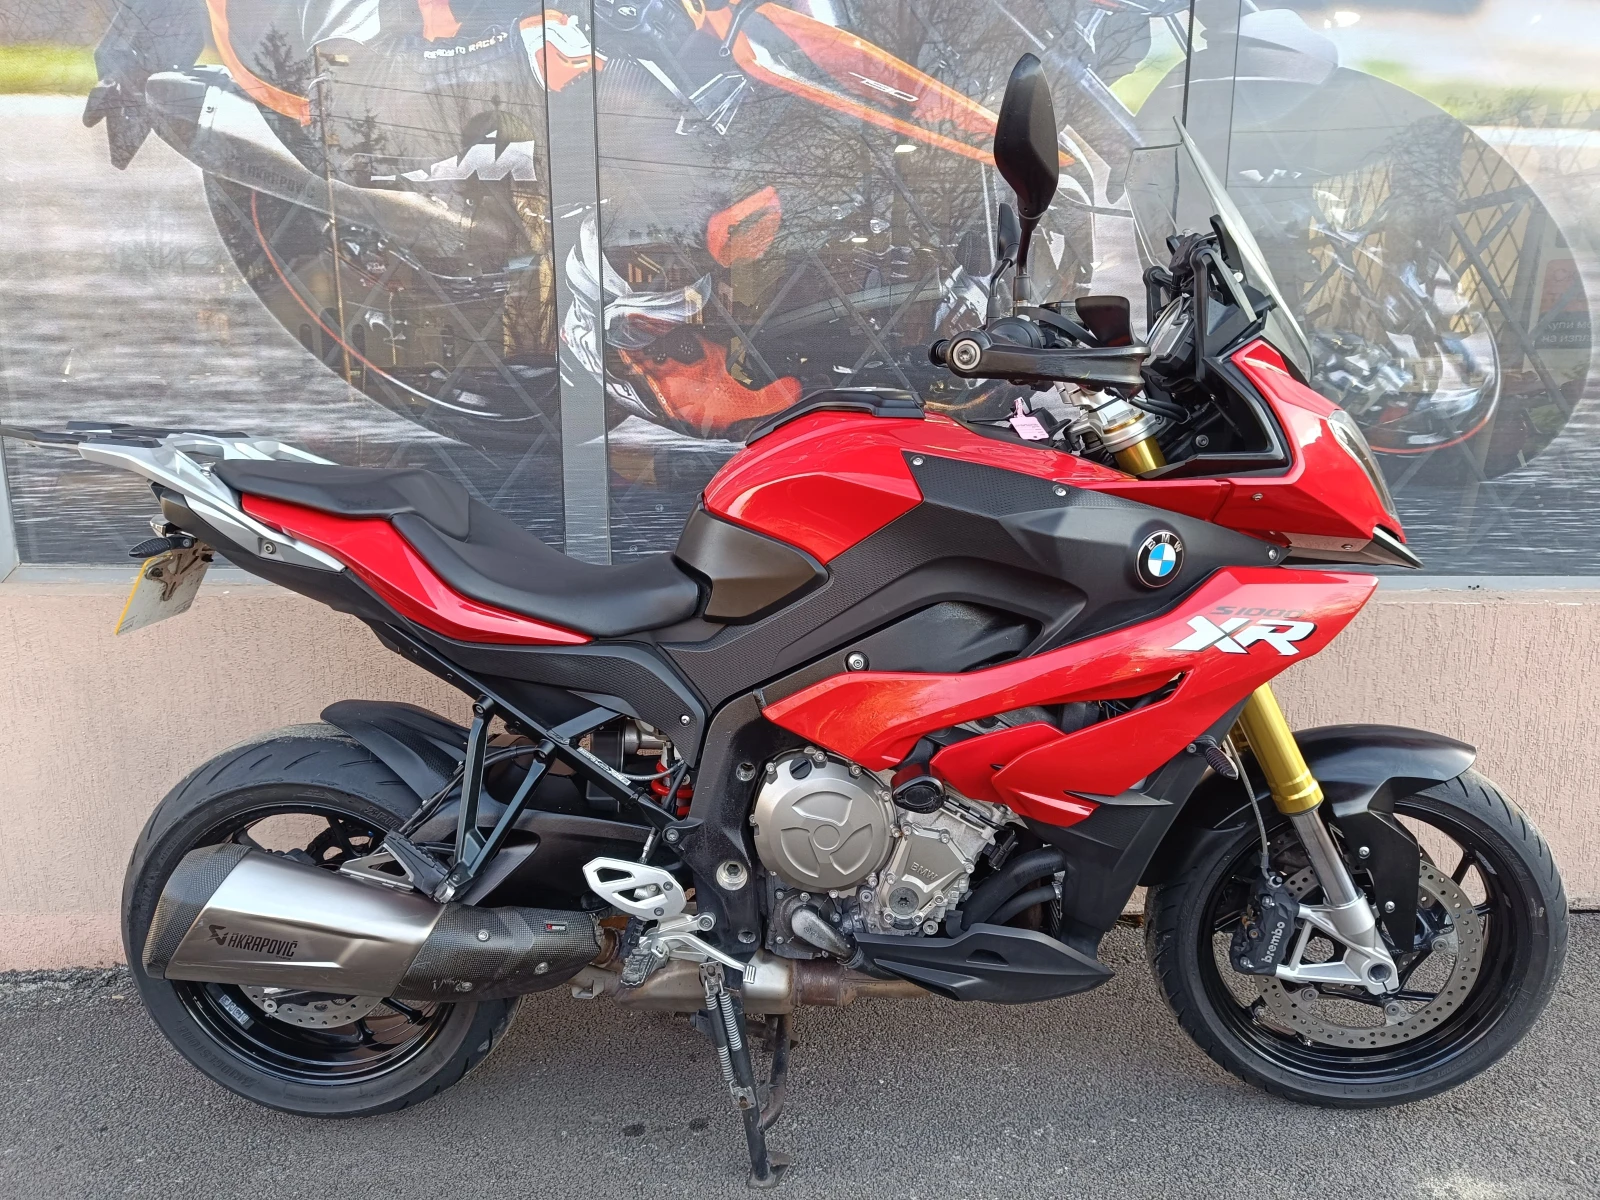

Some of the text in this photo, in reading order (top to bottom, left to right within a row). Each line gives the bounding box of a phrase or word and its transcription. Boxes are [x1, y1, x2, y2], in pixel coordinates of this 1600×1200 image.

[1145, 533, 1182, 552] BMW
[1210, 606, 1306, 618] S1000
[1163, 615, 1317, 656] XR
[911, 861, 938, 881] BMW
[228, 932, 298, 957] AKRAPOVIČ
[1261, 921, 1285, 963] brembo
